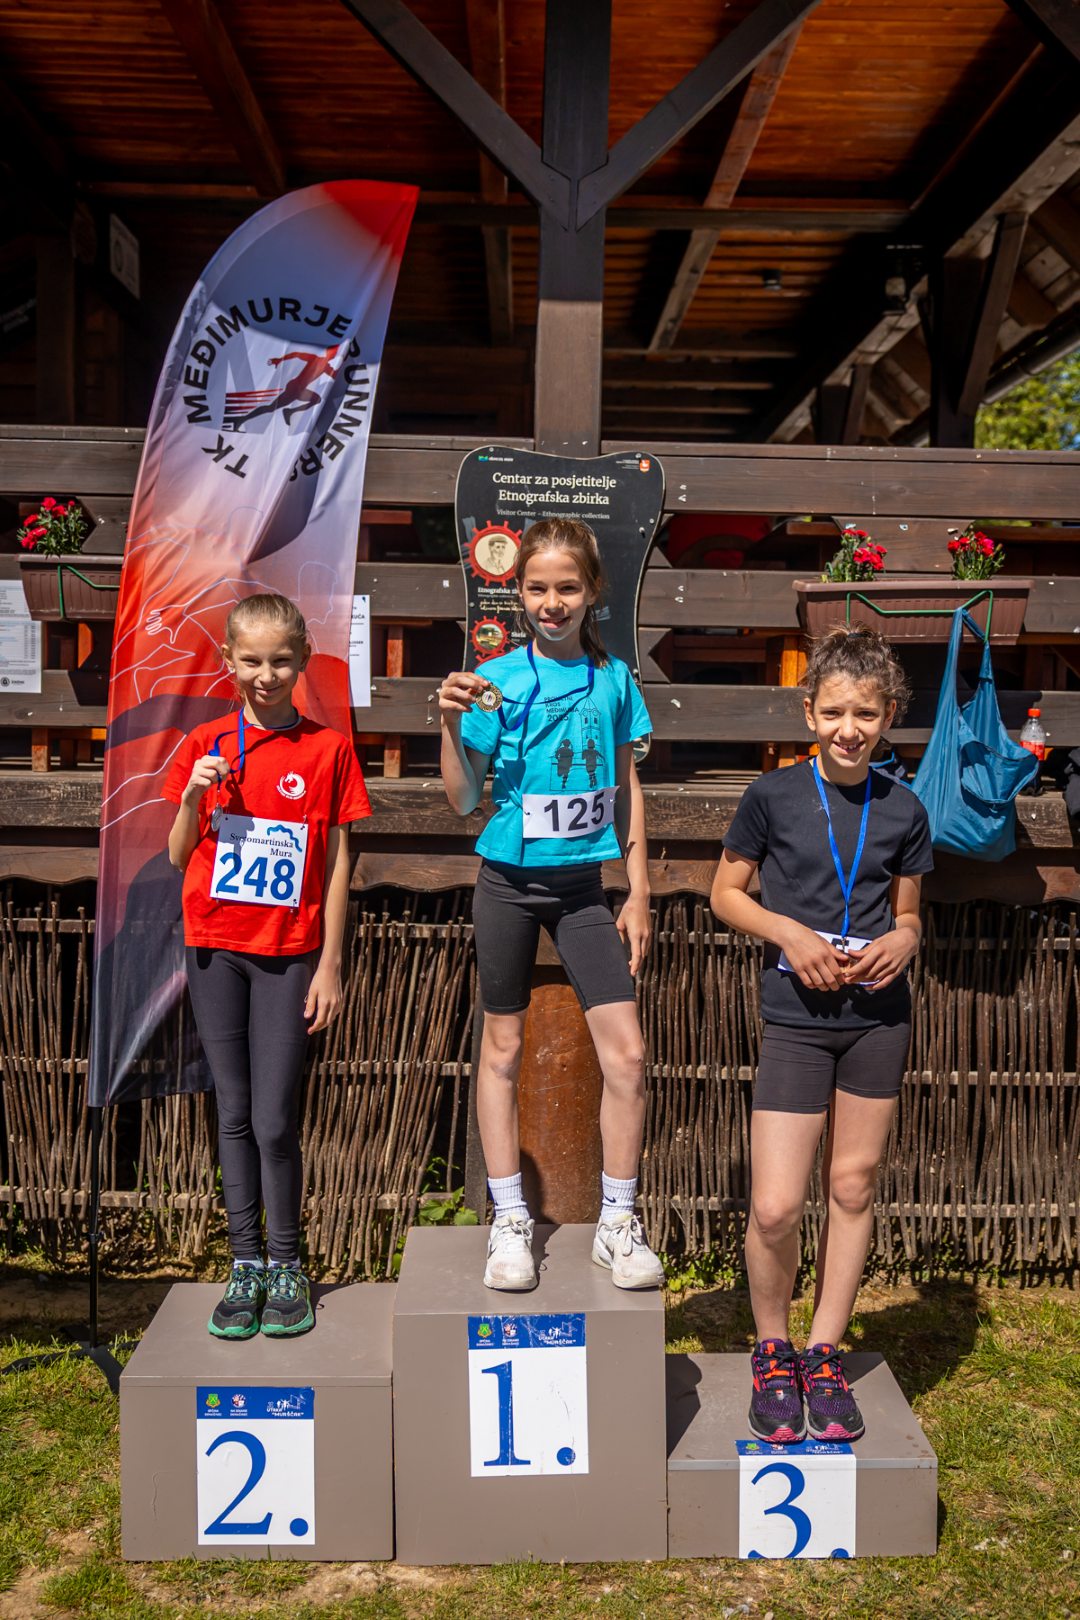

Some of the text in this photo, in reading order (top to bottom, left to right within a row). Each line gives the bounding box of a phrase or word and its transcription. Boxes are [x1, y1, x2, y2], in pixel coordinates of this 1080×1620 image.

[183, 297, 353, 424] MEĐIMURJE
[201, 434, 249, 479] TK
[492, 472, 617, 490] Centar za posjetitelje
[499, 489, 609, 507] Etnografska zbirka
[497, 508, 516, 516] Visitor
[517, 509, 536, 517] Center
[542, 510, 581, 519] Ethnographic
[582, 512, 610, 520] collection
[544, 792, 605, 832] 125
[230, 833, 294, 848] Svetomartinska
[269, 847, 293, 858] Mura
[216, 851, 296, 901] 248
[481, 1360, 576, 1467] 1.
[203, 1430, 309, 1537] 2.
